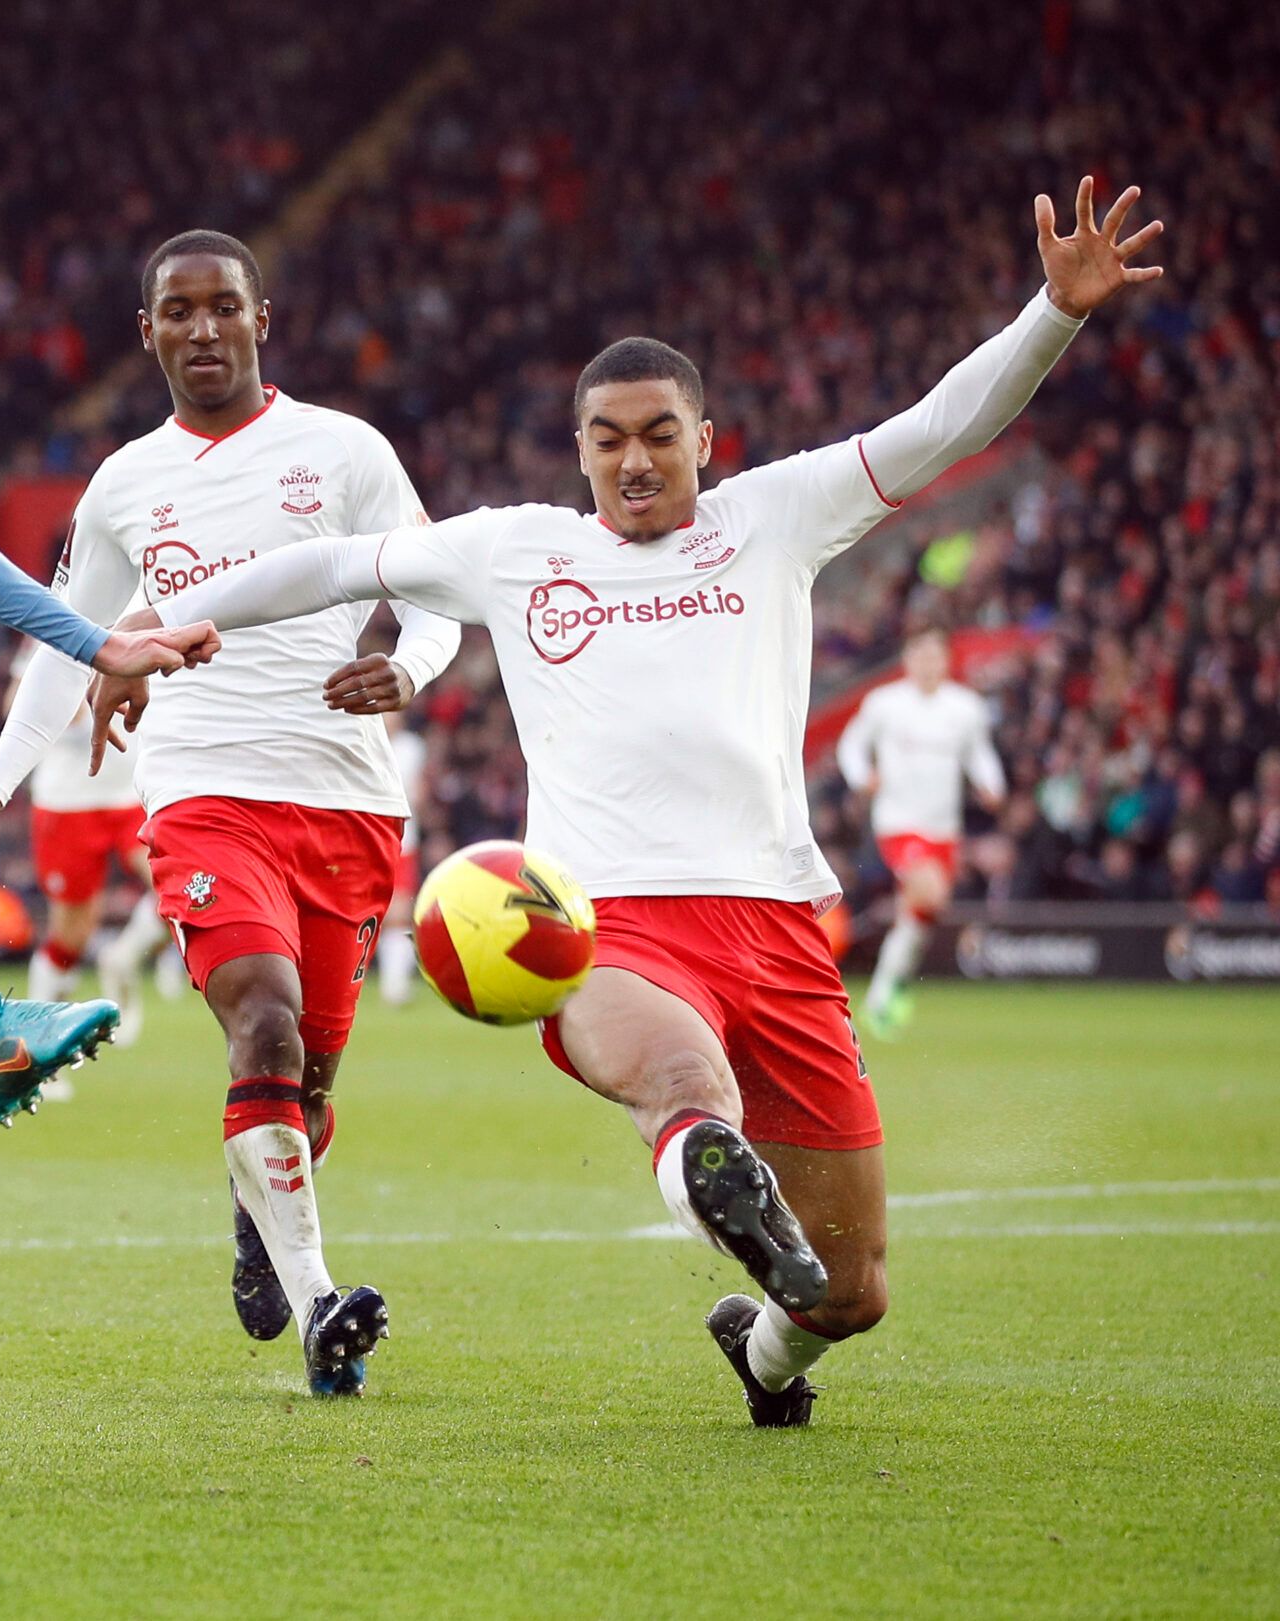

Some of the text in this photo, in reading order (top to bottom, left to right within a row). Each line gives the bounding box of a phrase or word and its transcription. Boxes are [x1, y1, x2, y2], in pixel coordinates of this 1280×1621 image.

[150, 519, 179, 534] hummel
[541, 585, 745, 640] Sportsbet.io
[350, 915, 378, 984] 2
